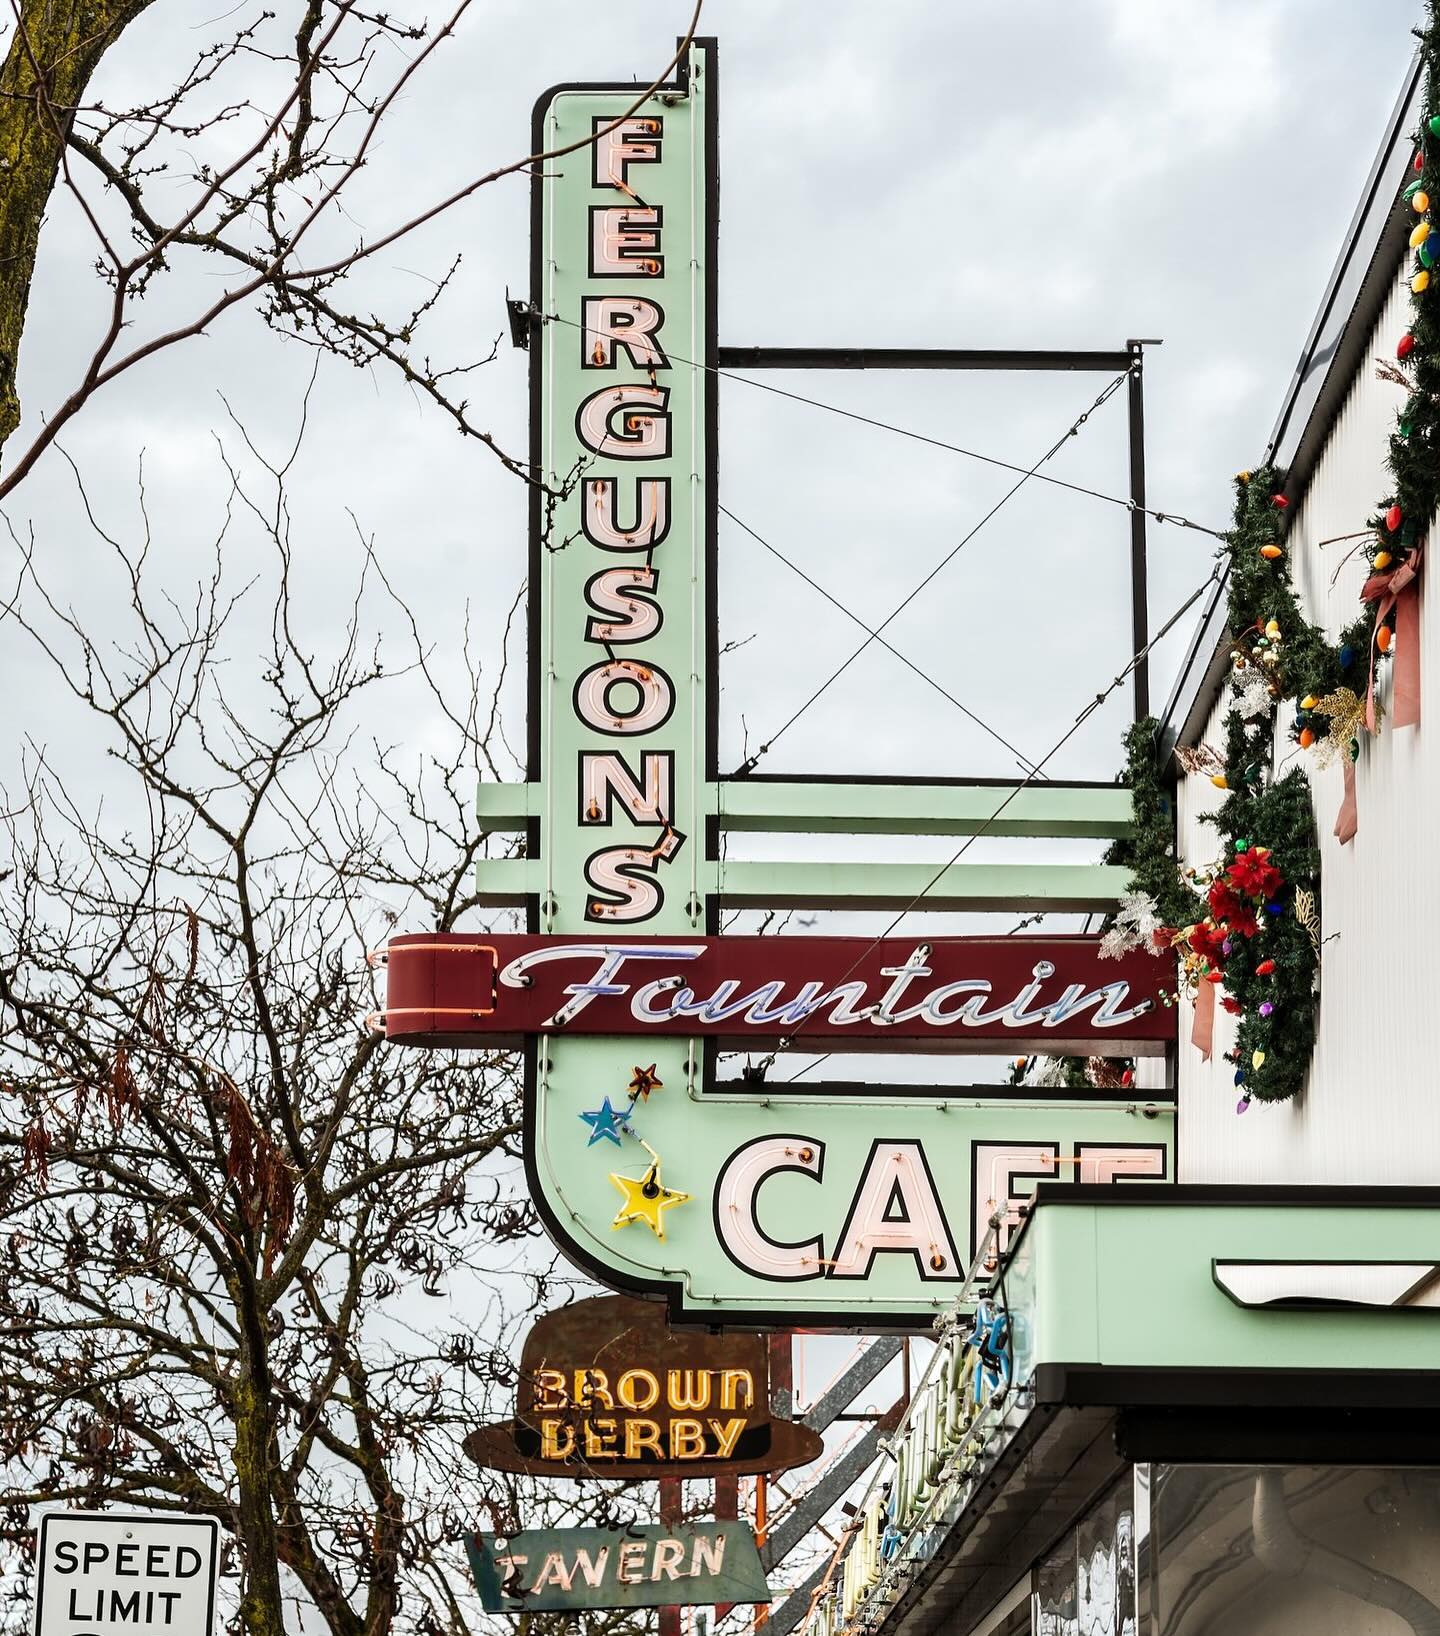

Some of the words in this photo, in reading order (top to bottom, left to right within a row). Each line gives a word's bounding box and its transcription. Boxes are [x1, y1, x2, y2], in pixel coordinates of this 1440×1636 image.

[573, 116, 687, 924] FERGUSON'S
[499, 943, 1153, 1027] Fountain
[540, 1418, 748, 1460] DERBY
[53, 1541, 202, 1578] SPEED
[494, 1535, 725, 1598] TAVERN
[69, 1588, 181, 1625] LIMIT
